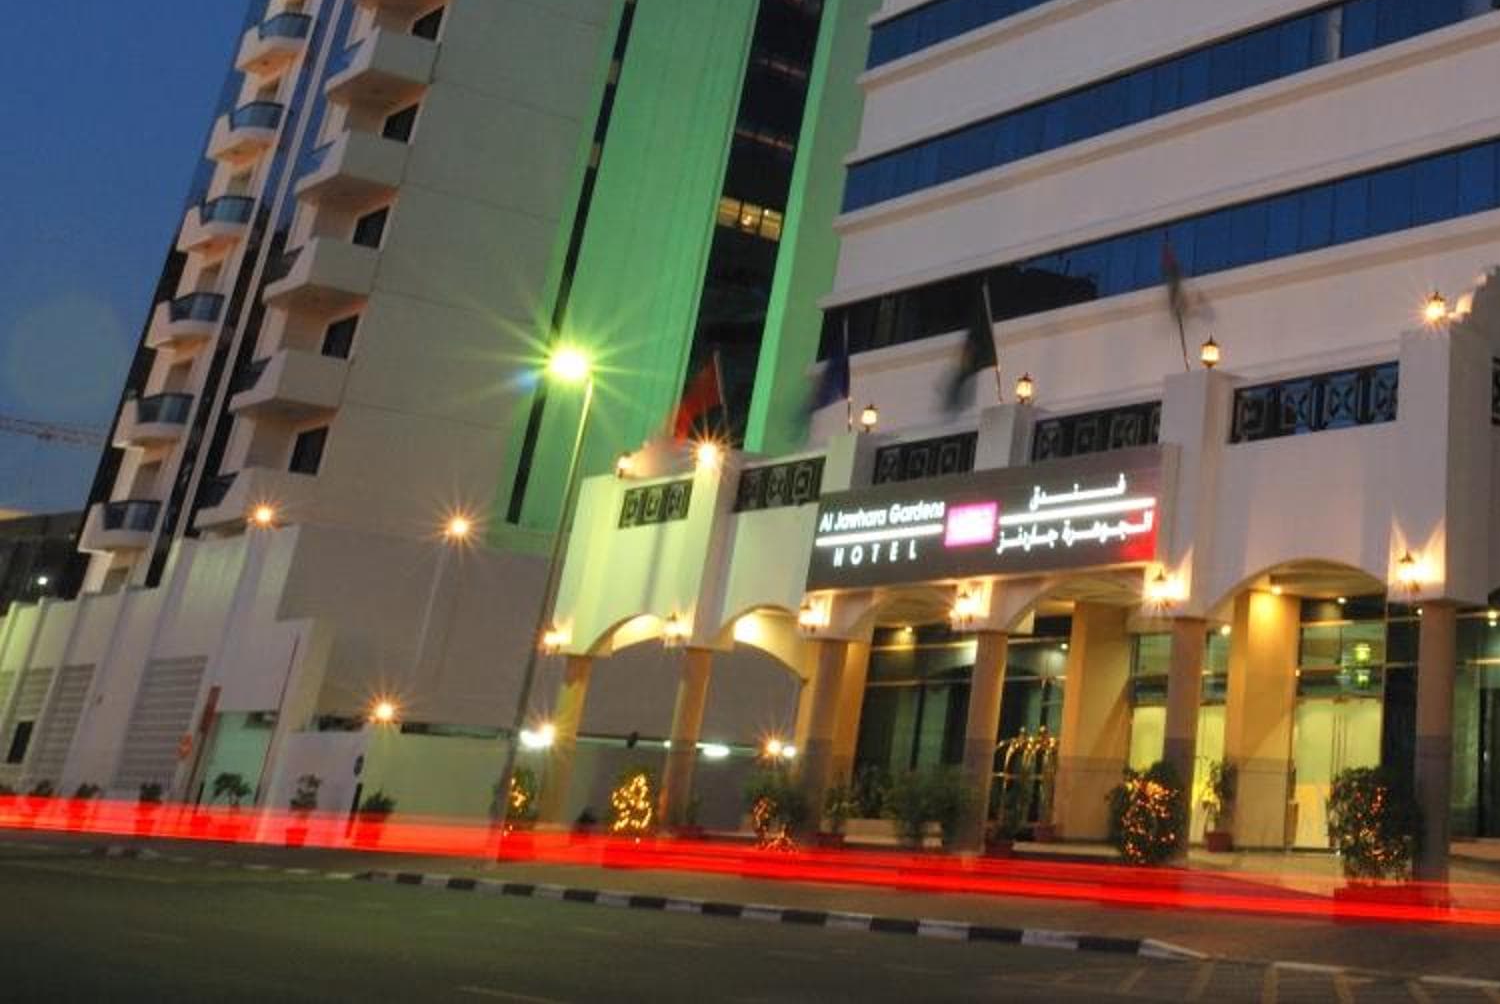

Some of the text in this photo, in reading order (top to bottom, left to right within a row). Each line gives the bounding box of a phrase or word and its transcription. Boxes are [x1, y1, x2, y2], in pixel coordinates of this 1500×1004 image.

[1029, 472, 1127, 512] فندق
[819, 500, 946, 532] Al Jawhara Gardens
[1061, 510, 1154, 547] الجوهرة
[833, 539, 917, 568] HOTEL
